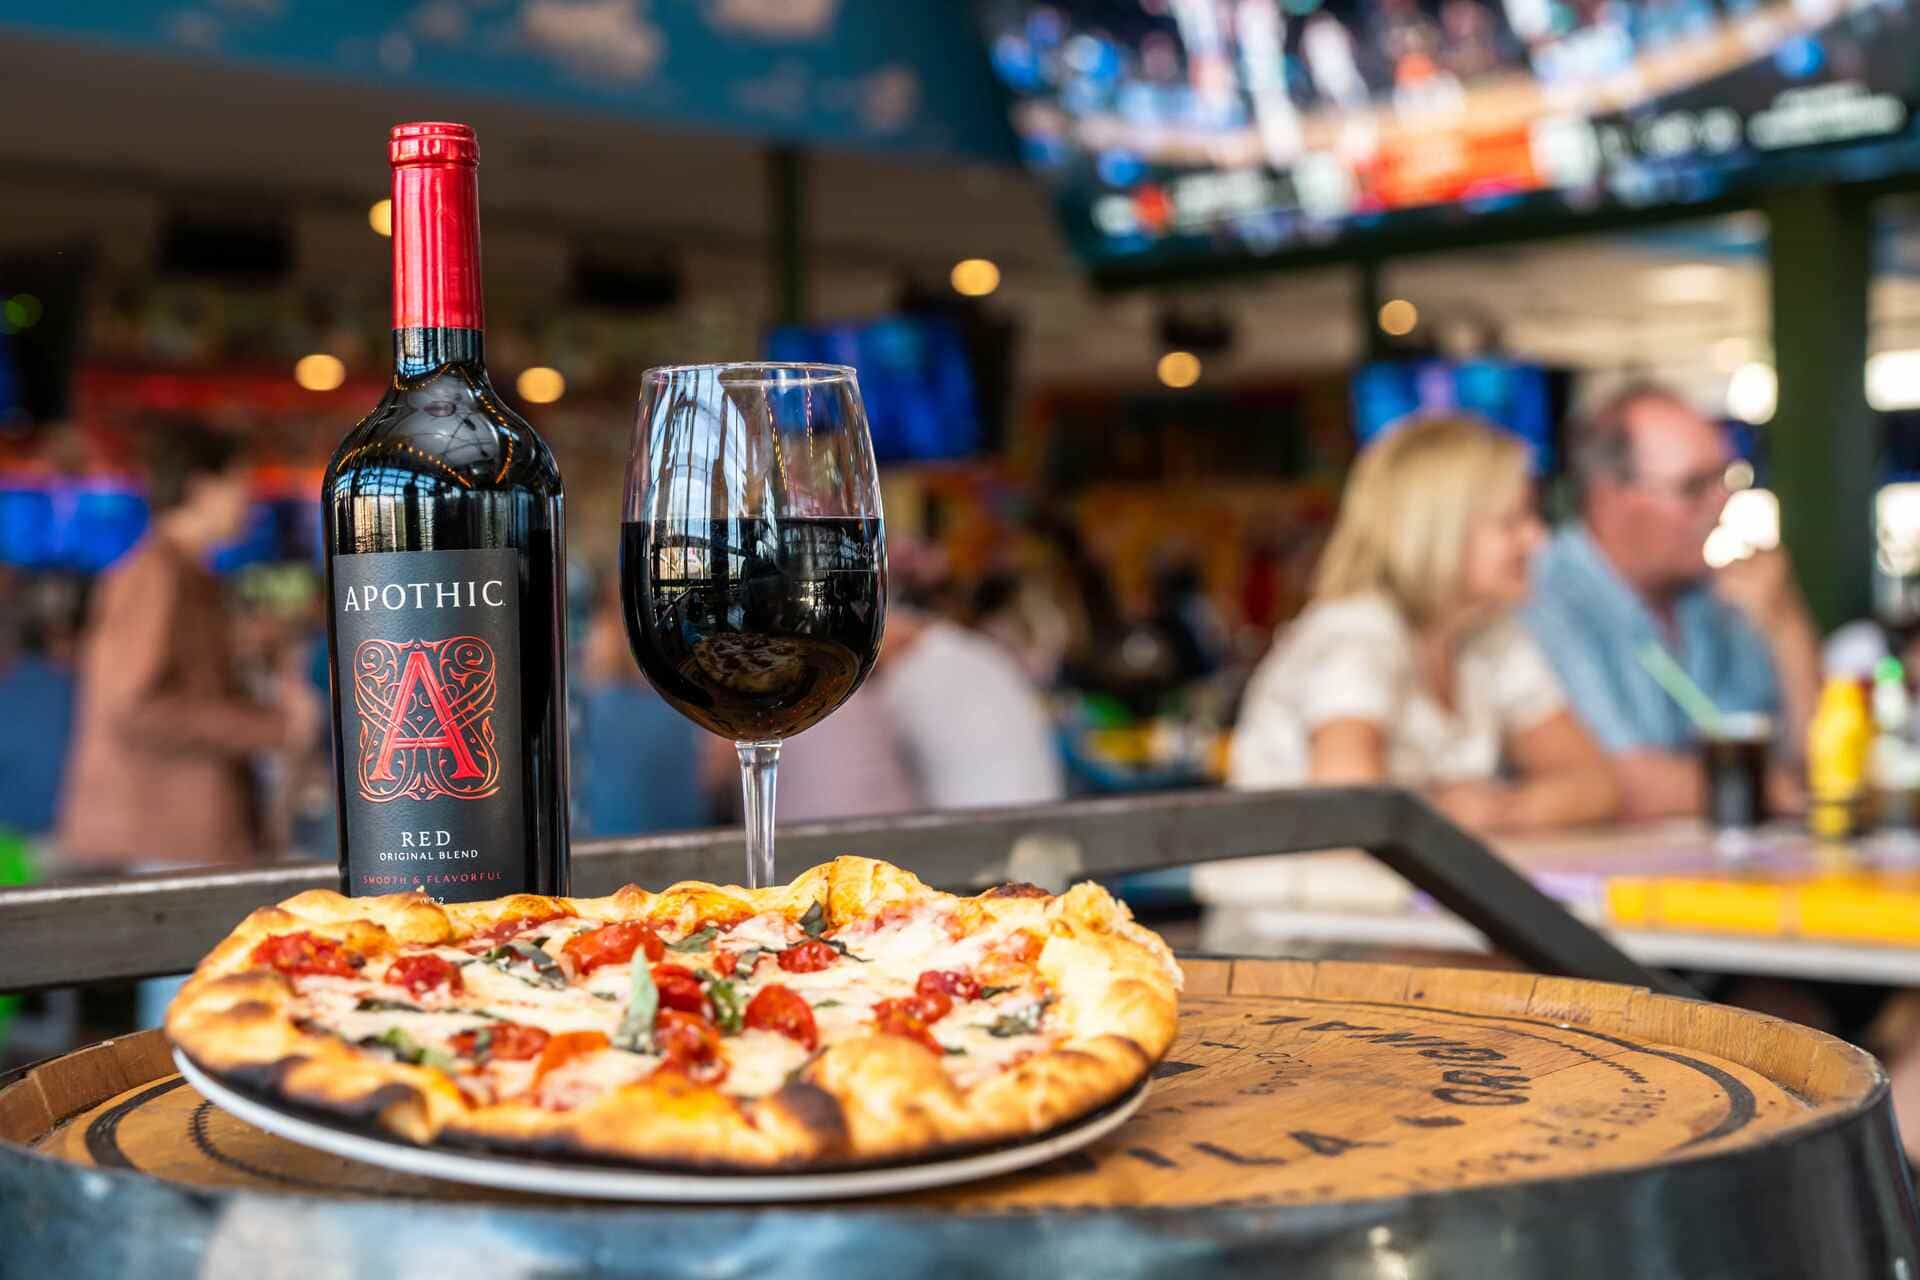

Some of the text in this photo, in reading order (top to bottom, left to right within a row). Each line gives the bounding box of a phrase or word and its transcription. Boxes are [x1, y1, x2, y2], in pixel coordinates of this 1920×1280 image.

[344, 580, 507, 612] APOTHIC
[400, 831, 451, 848] RED
[379, 850, 478, 861] ORIGINAL BLEND
[362, 875, 407, 885] SMOOTH
[427, 872, 503, 884] FLAVORFUL
